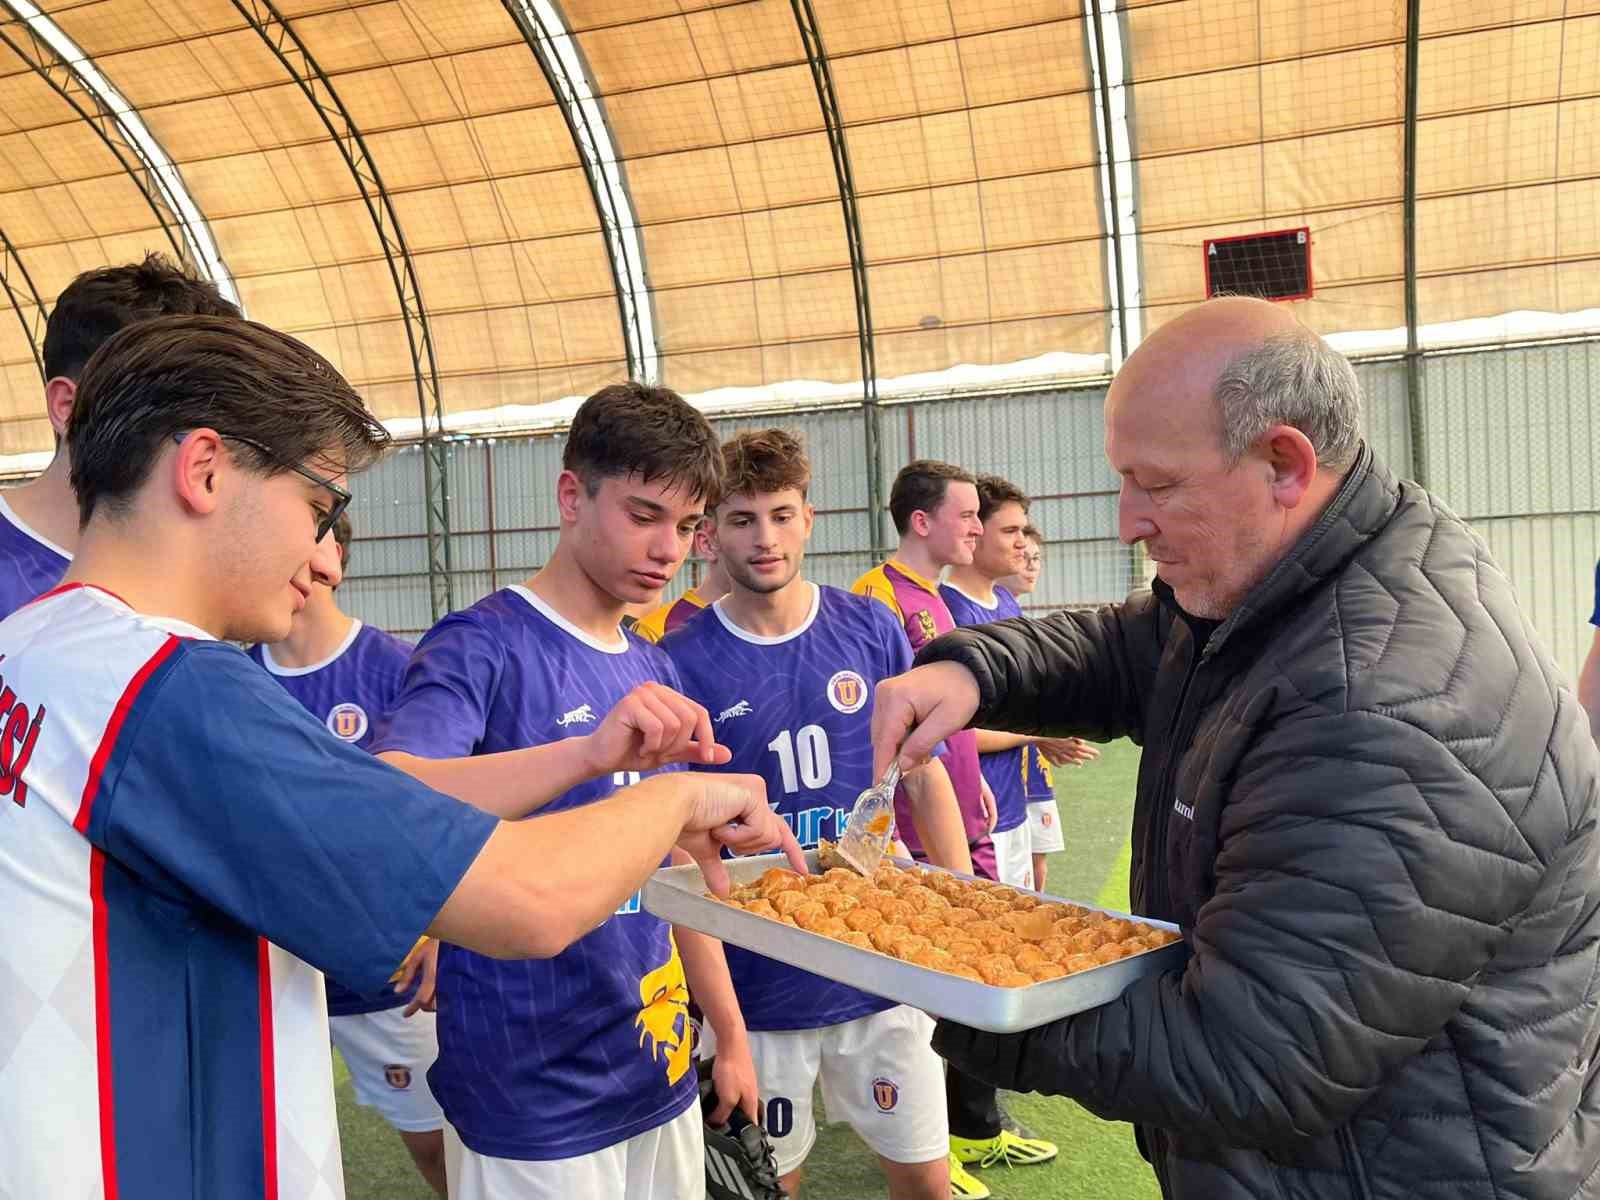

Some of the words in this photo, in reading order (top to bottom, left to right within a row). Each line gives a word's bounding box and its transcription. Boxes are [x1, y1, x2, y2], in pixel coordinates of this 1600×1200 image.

[1208, 242, 1217, 255] A
[1297, 231, 1306, 244] B
[838, 680, 857, 704] U
[336, 712, 357, 736] U
[768, 724, 832, 793] 10
[767, 1097, 793, 1138] 0
